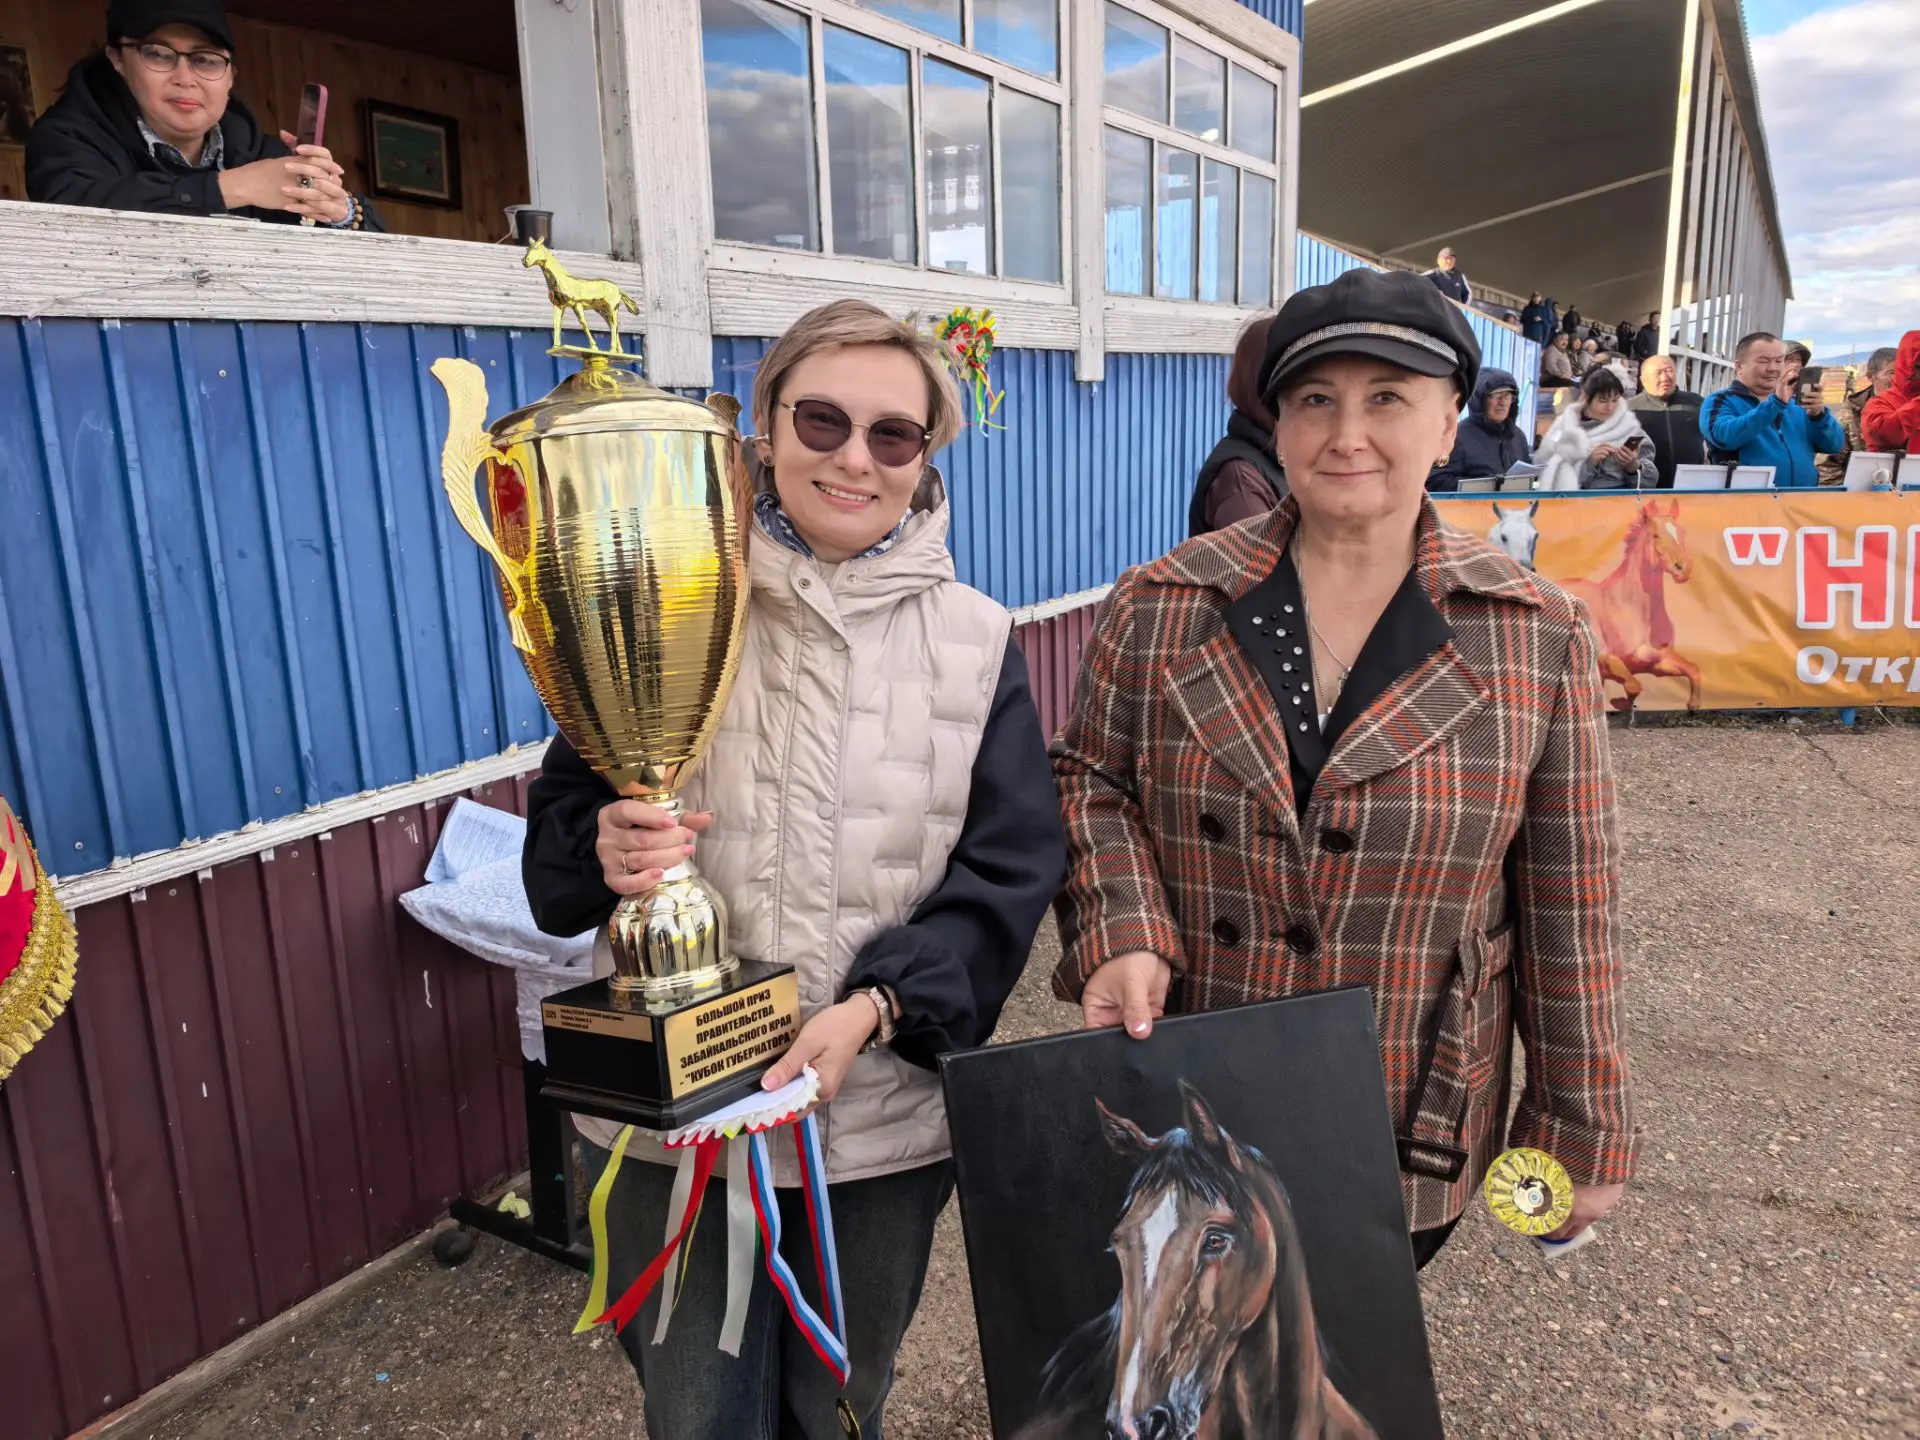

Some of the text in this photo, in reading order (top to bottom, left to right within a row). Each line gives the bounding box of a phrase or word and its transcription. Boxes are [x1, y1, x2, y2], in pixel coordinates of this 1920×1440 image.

[696, 988, 771, 1027] БОЛЬШОЙ ПРИЗ
[696, 1004, 775, 1044] ПРАВИТЕЛЬСТВА
[680, 1013, 792, 1069] ЗАБАЙКАЛЬСКОГО КРАЯ
[685, 1059, 725, 1084] "КУБОК
